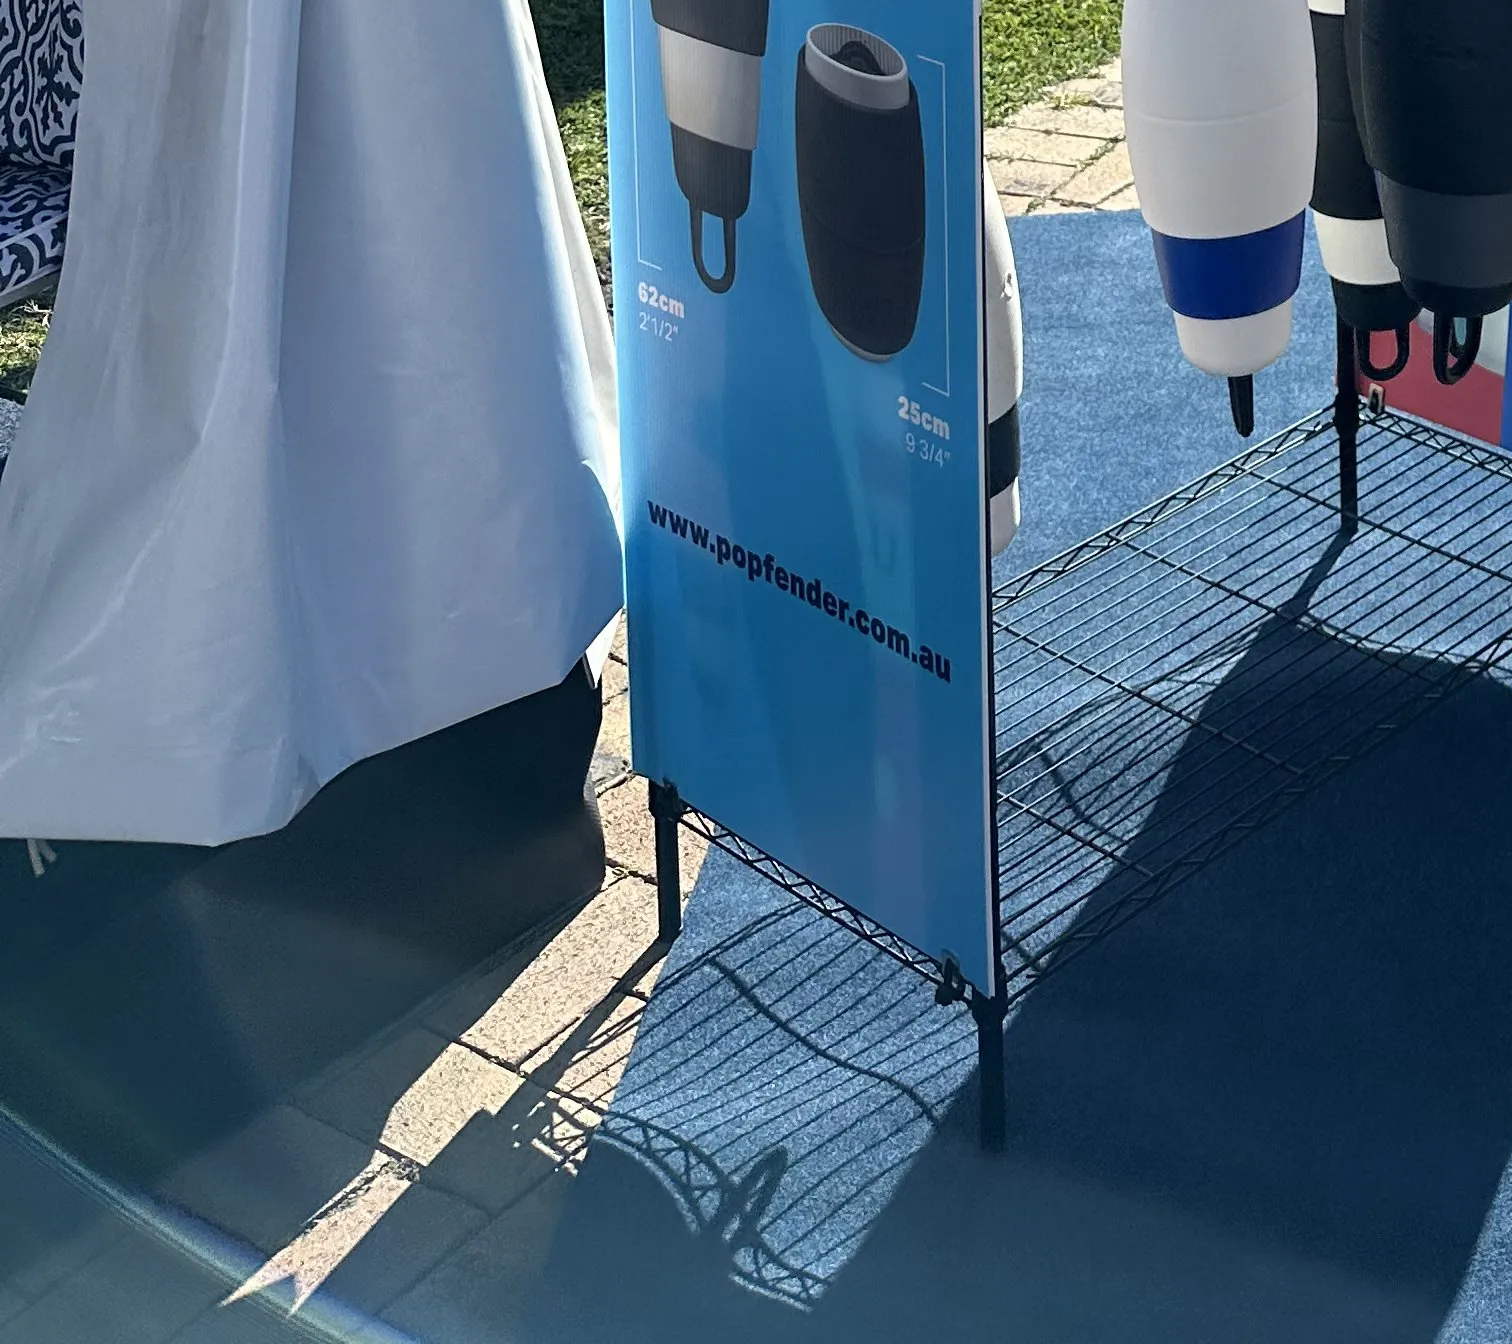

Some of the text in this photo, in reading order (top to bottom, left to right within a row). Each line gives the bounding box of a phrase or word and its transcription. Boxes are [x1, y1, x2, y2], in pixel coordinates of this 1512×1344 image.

[638, 281, 685, 319] 62cm
[897, 395, 951, 440] 25cm
[905, 433, 916, 453] 9
[647, 499, 952, 684] www.popfender.com.au
